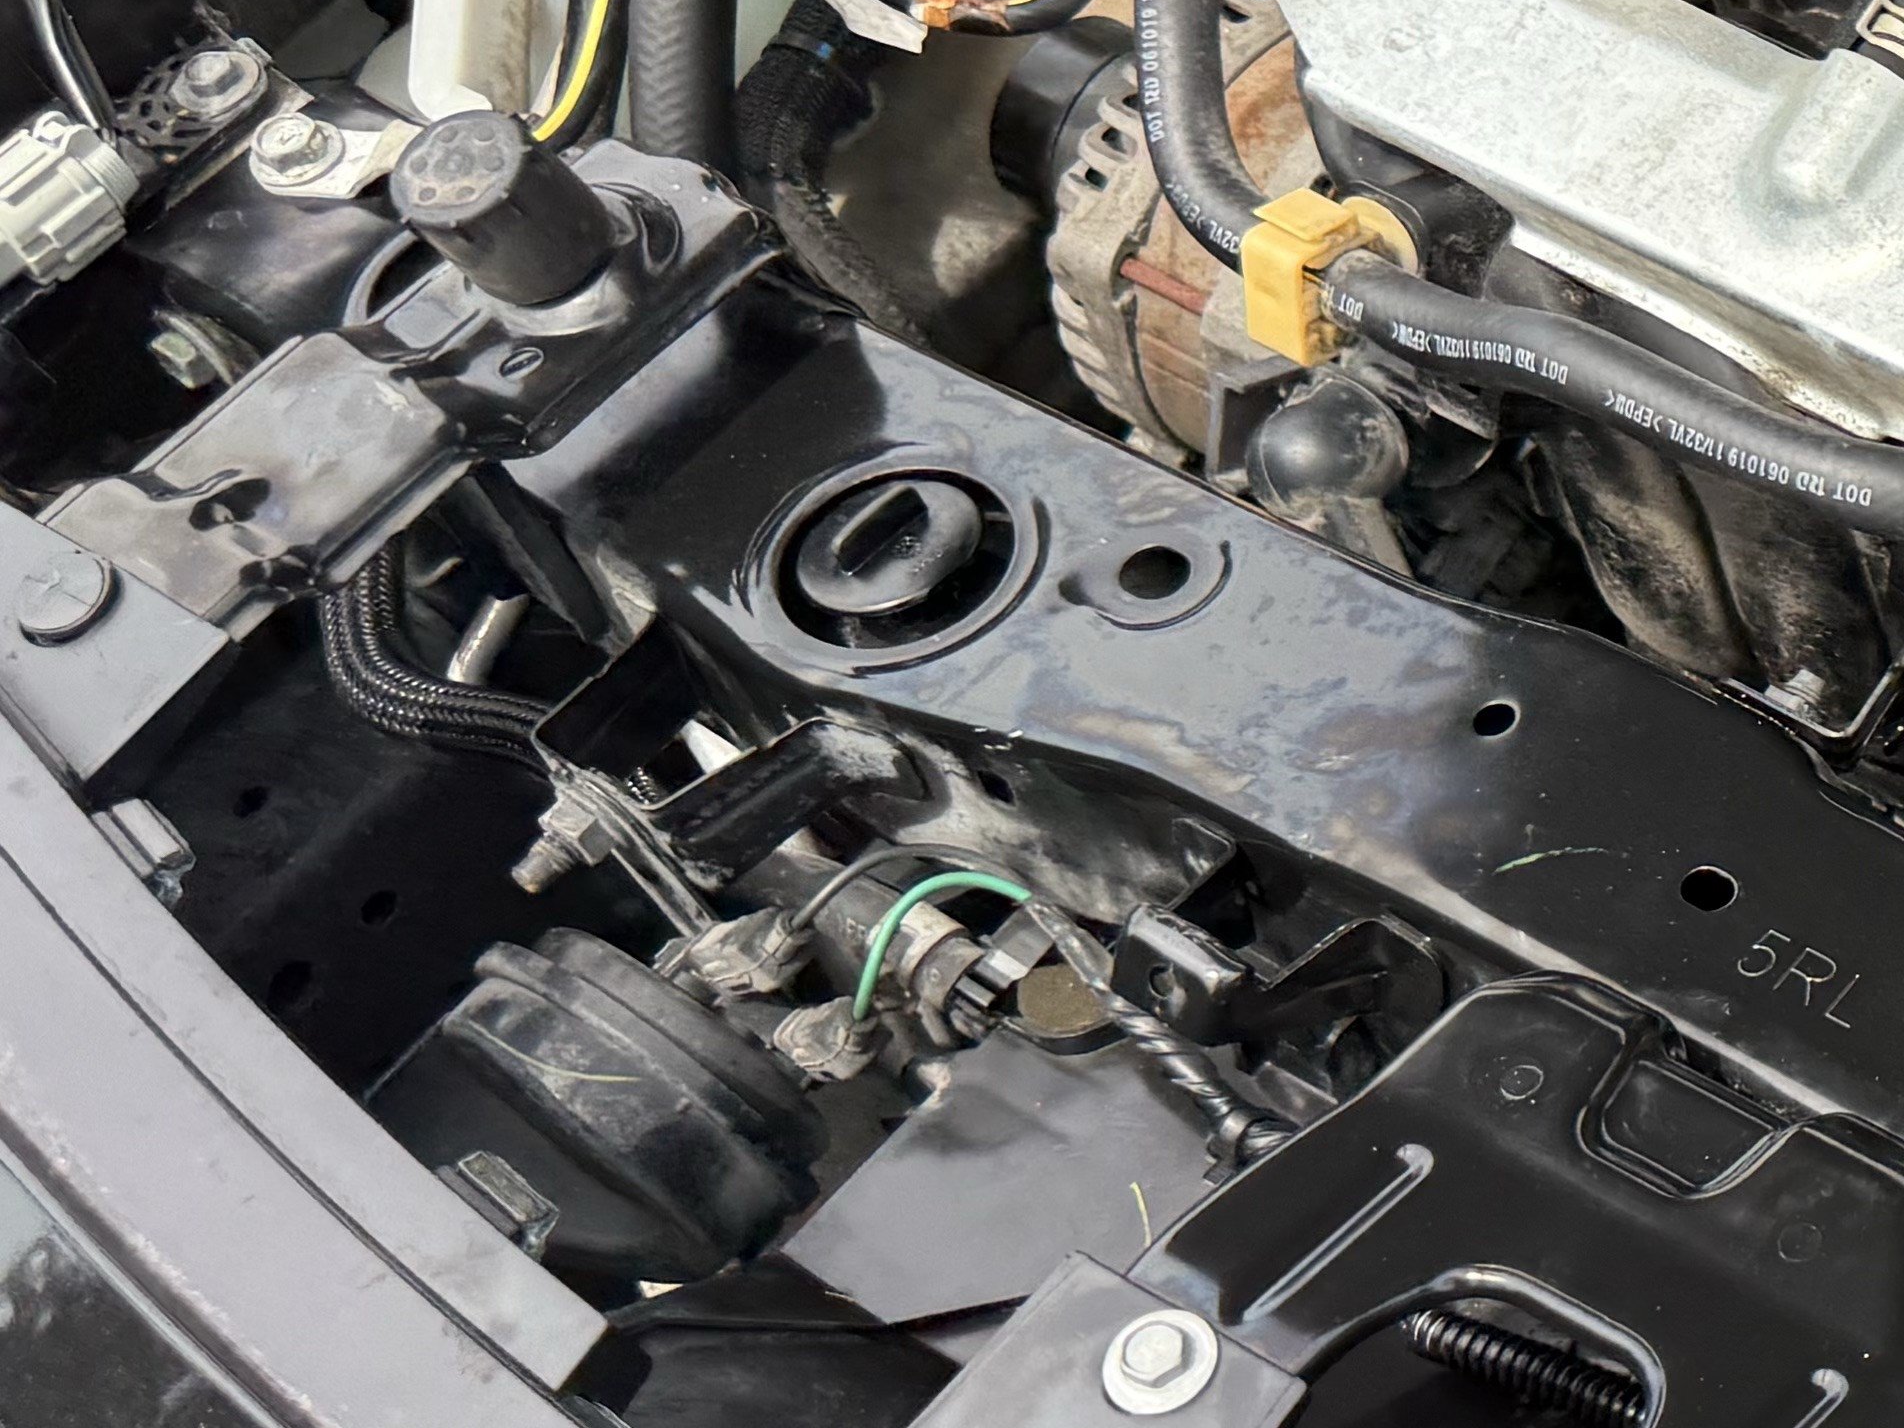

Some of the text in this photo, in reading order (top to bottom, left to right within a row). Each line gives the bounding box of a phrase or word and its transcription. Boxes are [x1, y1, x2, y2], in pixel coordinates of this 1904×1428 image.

[1144, 110, 1164, 142] DOT
[1539, 356, 1568, 381] DOT
[1661, 418, 1728, 461] 11/32VL
[1725, 446, 1792, 485] 061019
[1832, 478, 1873, 508] DOT
